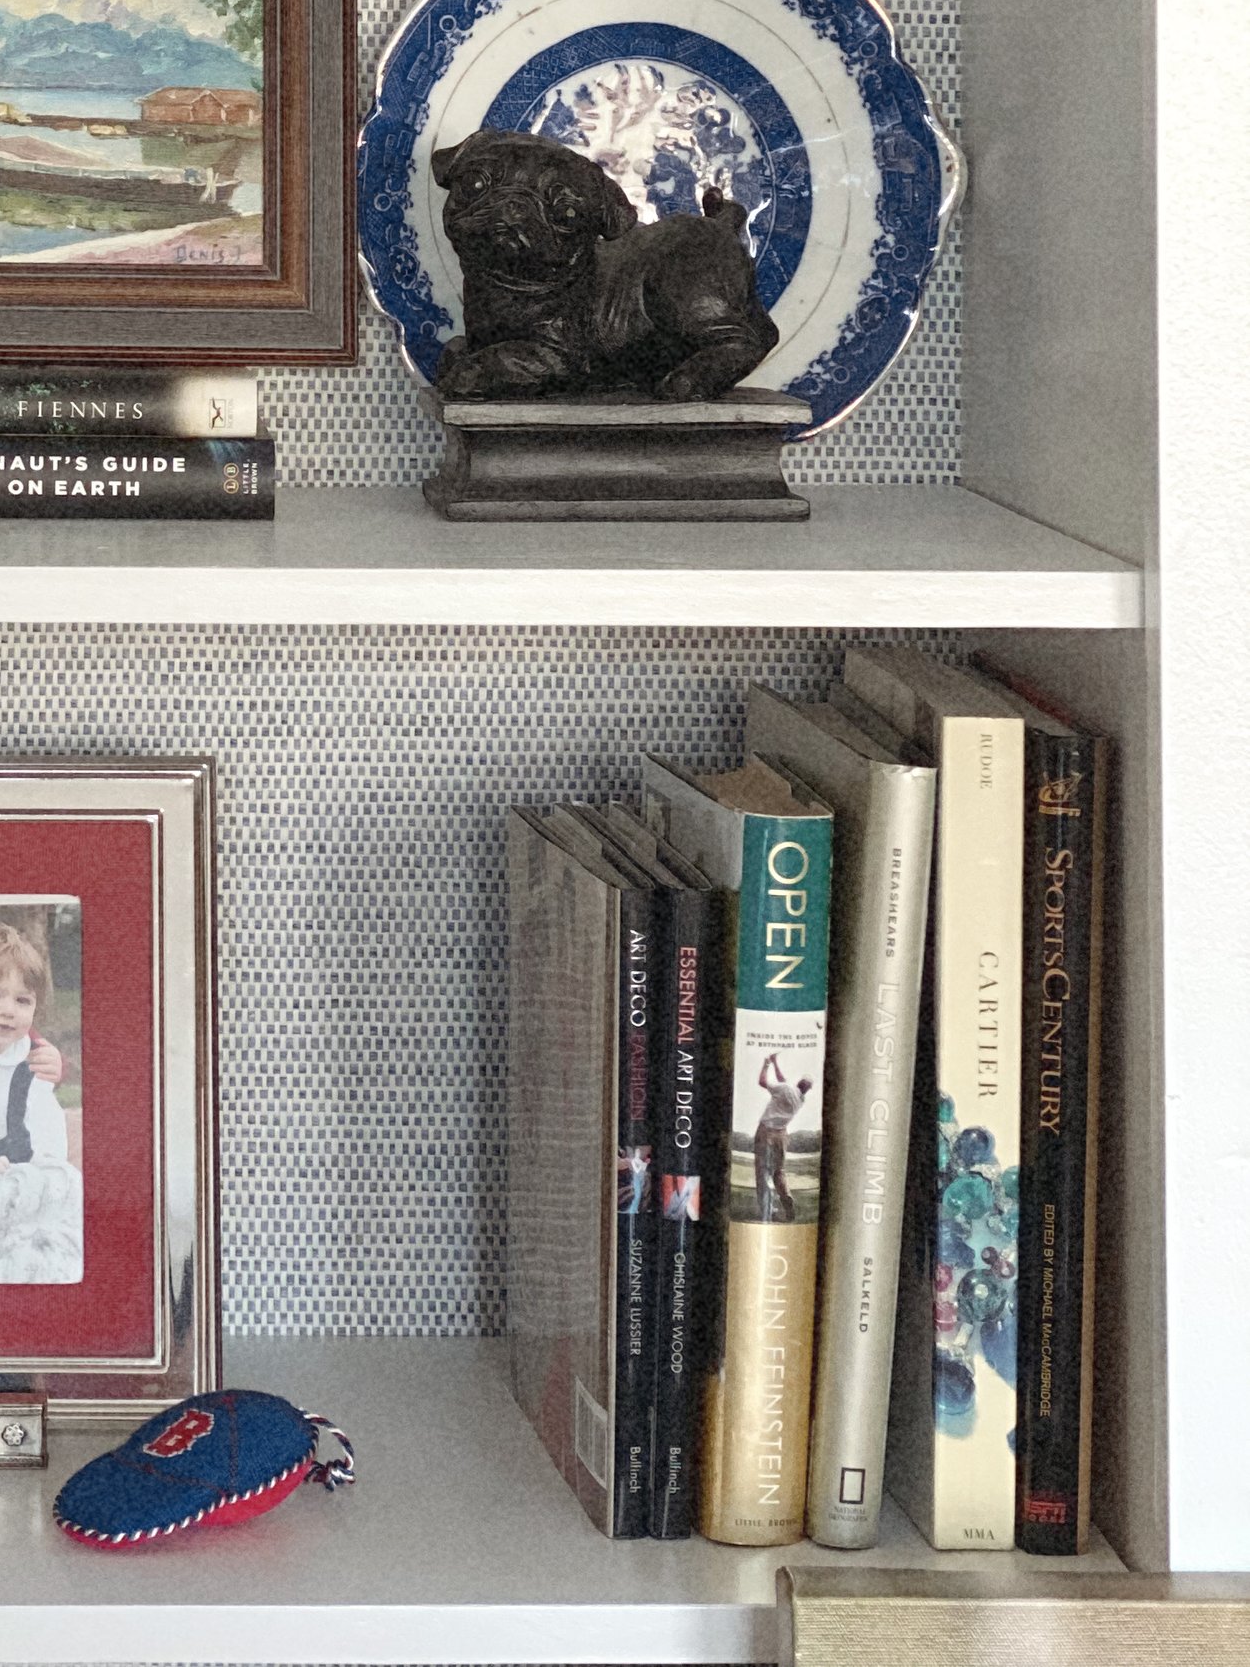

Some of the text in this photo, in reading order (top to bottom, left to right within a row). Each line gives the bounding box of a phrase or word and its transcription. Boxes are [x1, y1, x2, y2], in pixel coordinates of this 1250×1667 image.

[17, 400, 144, 420] FIENNES
[8, 479, 44, 496] ON
[54, 481, 141, 497] EARTH
[102, 457, 186, 473] GUIDE
[979, 733, 993, 790] RUDOE
[764, 841, 809, 990] OPEN
[884, 848, 902, 958] BREASHEARS
[628, 929, 647, 1121] ART DECO FASHION
[674, 947, 697, 1149] ESSENTIAL ART DECO
[977, 950, 999, 1099] CARTIER
[862, 982, 900, 1225] LAST CLIMB
[1042, 1248, 1054, 1265] BY
[1043, 1204, 1055, 1246] EDITED
[629, 1238, 643, 1356] SUZANNE LUSSIER
[670, 1253, 687, 1374] GHISLAINE WOOD
[763, 1244, 789, 1329] JOHN
[859, 1257, 873, 1333] SALKELD
[1042, 1268, 1054, 1319] MICHAEL
[142, 1408, 215, 1458] B
[757, 1346, 786, 1505] FEINSTEIN
[629, 1446, 641, 1494] Bulfinch
[669, 1447, 681, 1495] Bulfinch
[963, 1527, 995, 1540] MMA
